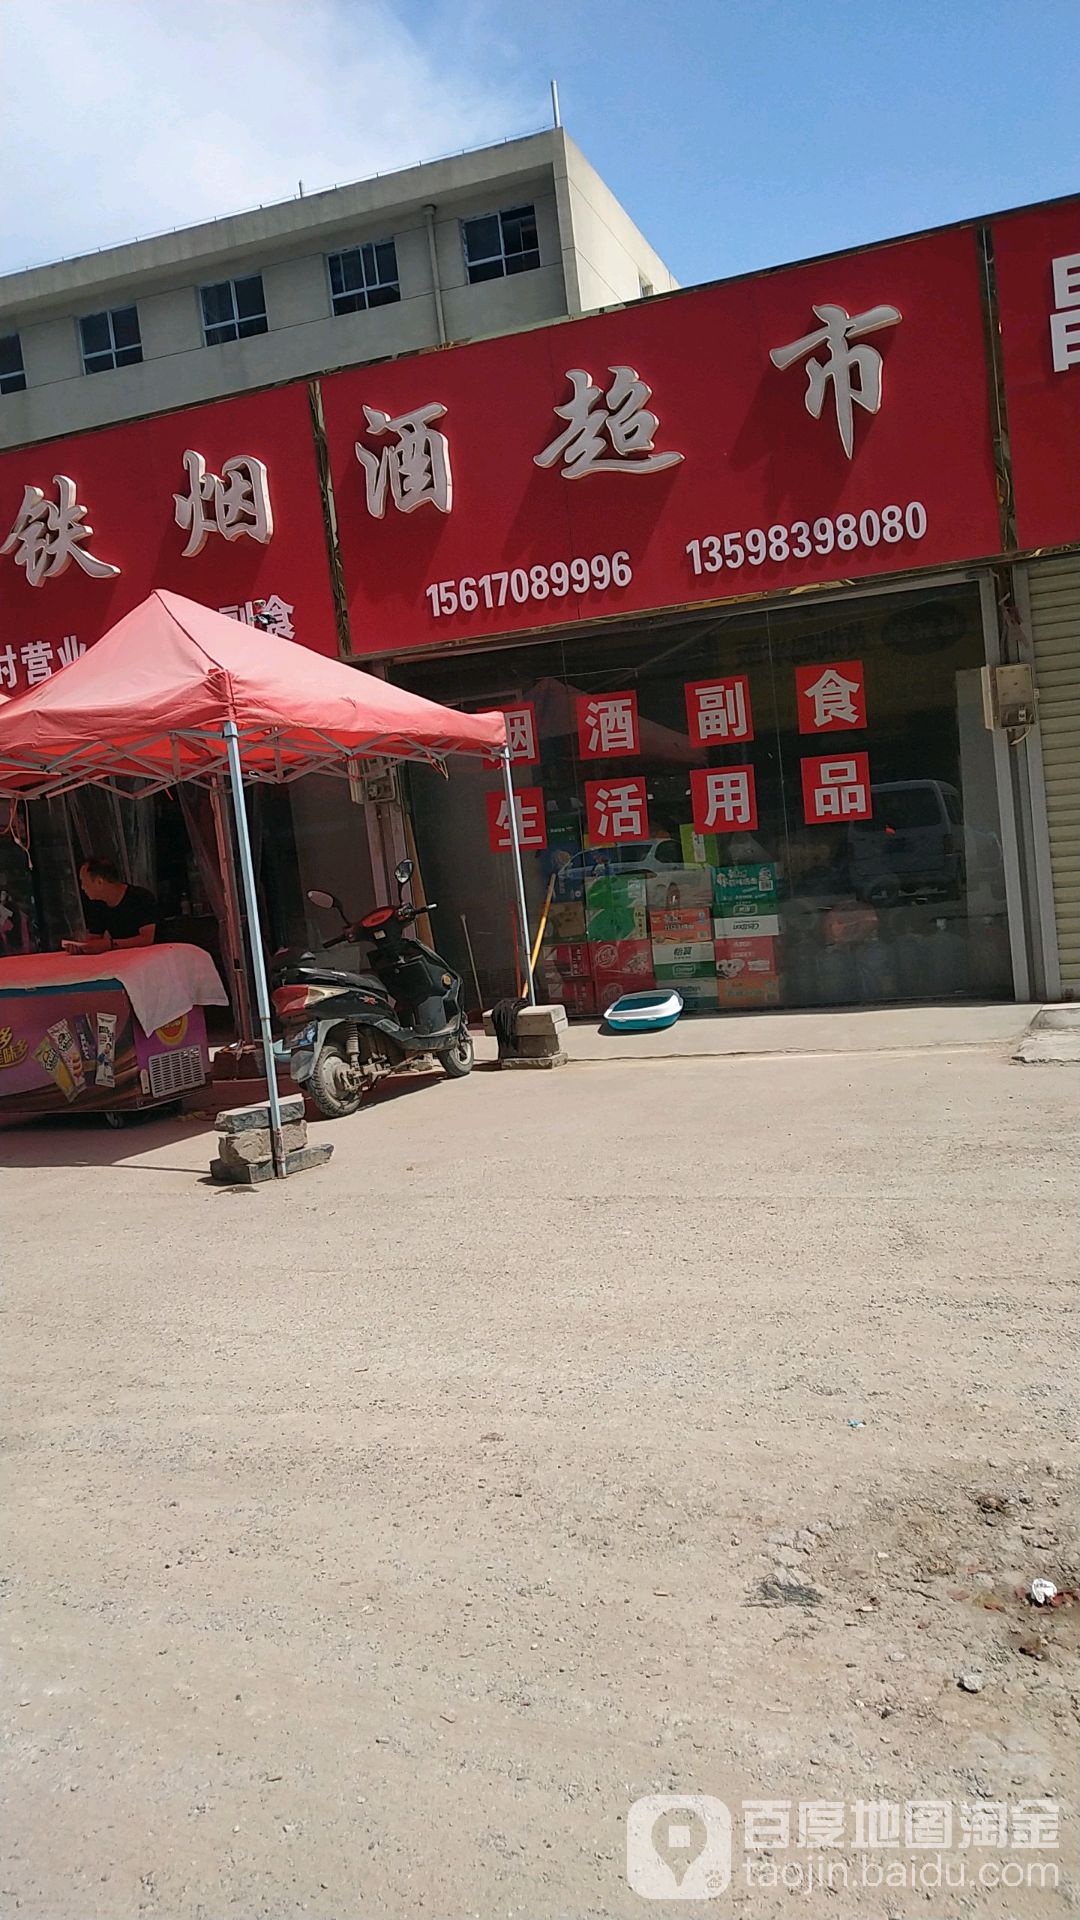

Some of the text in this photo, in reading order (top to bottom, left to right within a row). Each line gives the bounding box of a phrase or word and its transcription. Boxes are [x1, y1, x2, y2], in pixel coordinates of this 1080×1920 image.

[425, 500, 928, 618] 15617089996 13598398080
[496, 760, 863, 846] 生活用品
